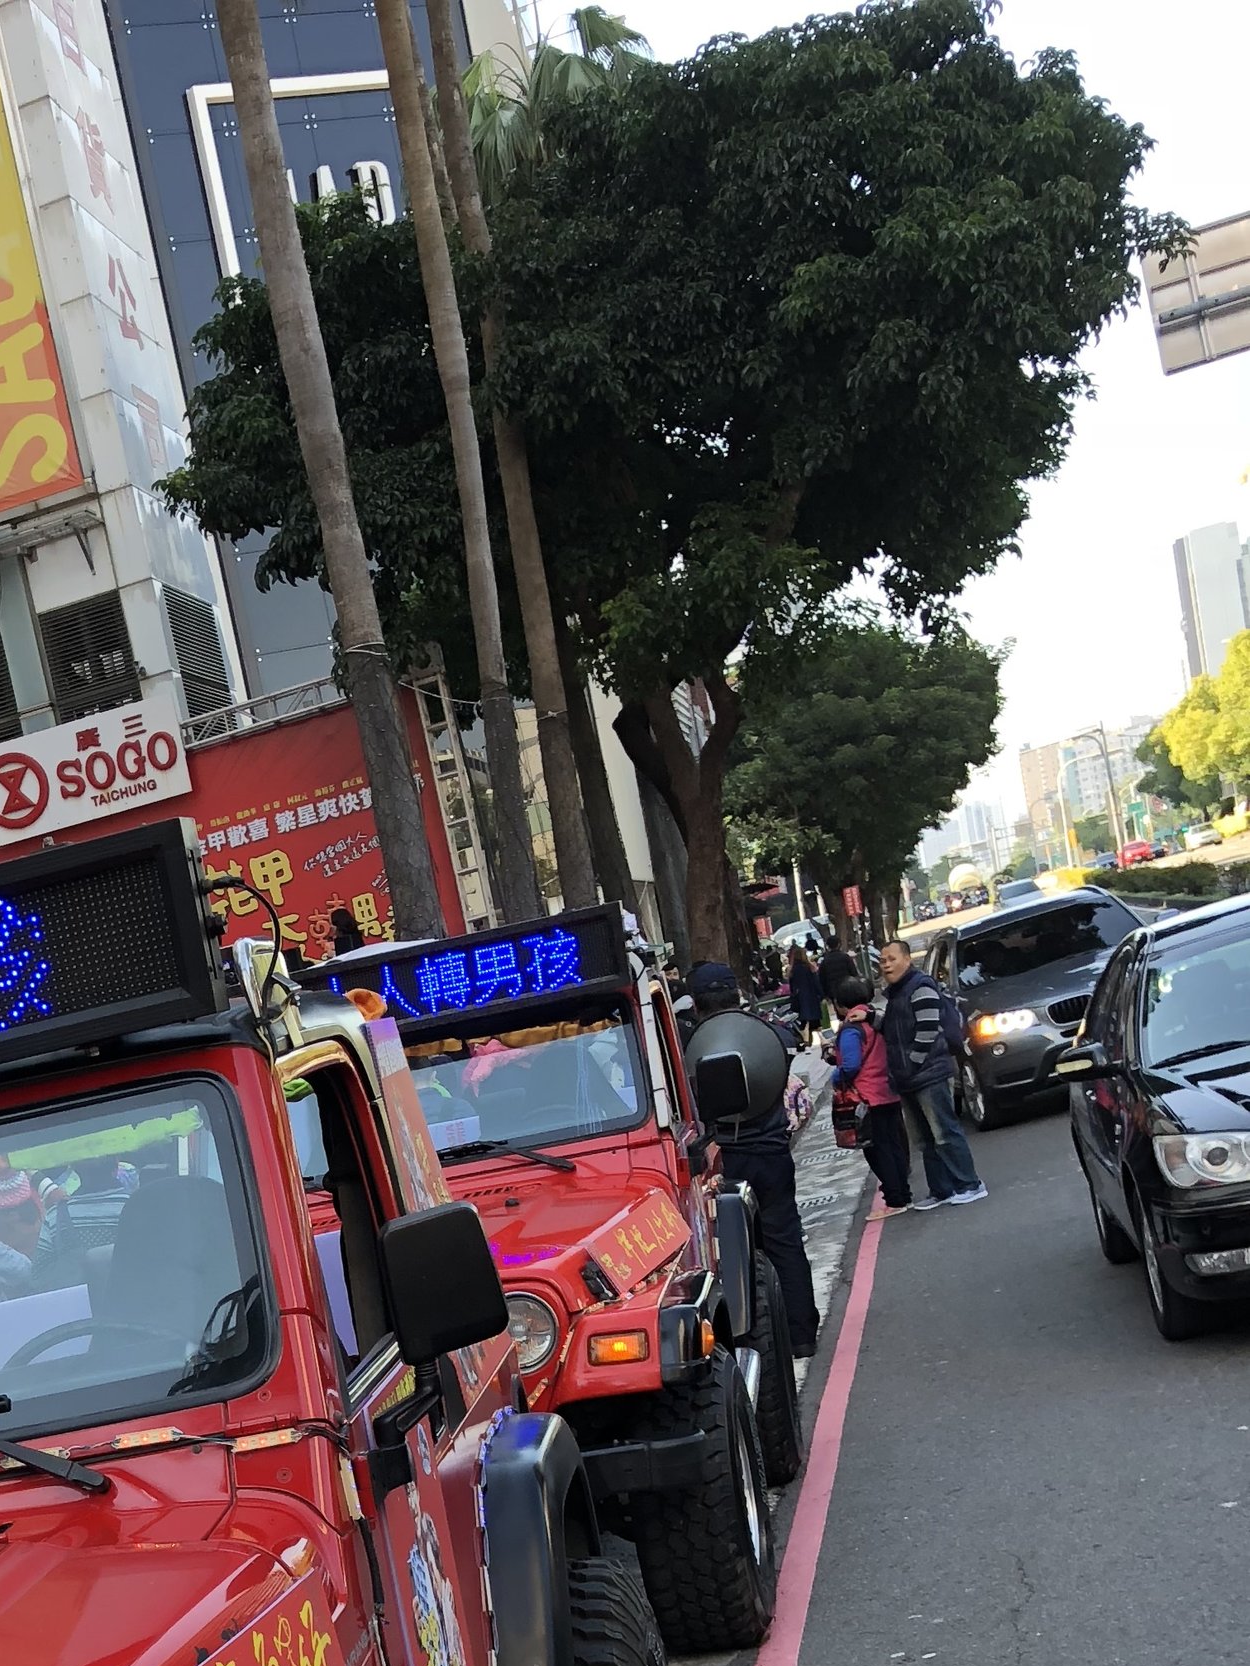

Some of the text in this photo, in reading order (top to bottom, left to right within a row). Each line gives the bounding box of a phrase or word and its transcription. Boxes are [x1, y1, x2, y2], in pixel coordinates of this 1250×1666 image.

[56, 731, 178, 800] SOGO
[91, 780, 158, 808] TAICHUNG
[329, 925, 584, 1018] 人轉男孩
